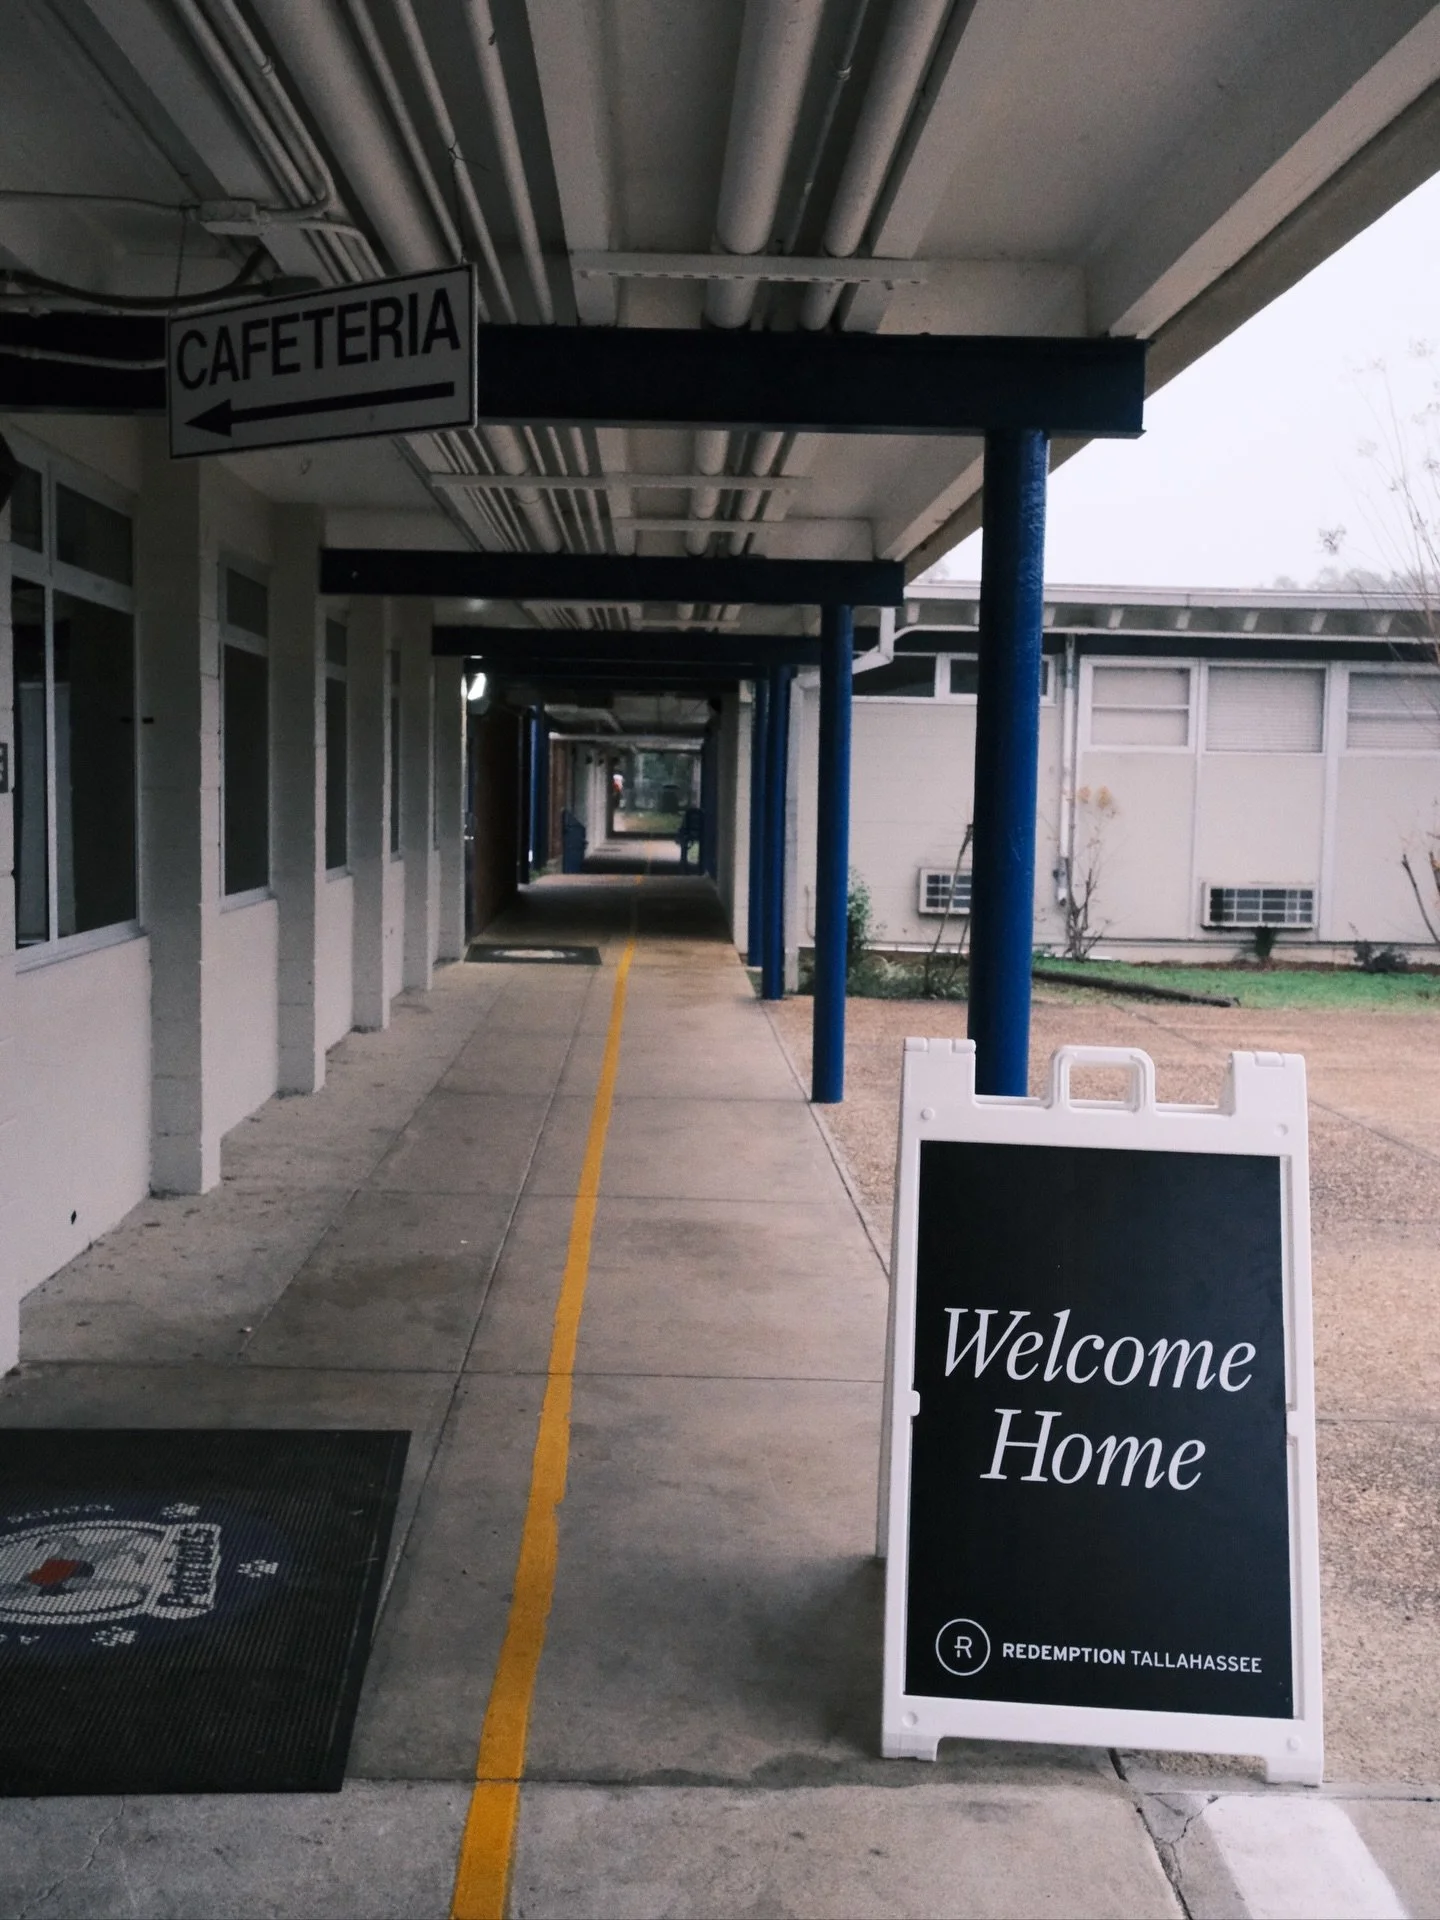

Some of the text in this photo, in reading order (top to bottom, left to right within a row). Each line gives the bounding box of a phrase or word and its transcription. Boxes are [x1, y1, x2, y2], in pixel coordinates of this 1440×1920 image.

[176, 287, 461, 390] CAFETERIA
[943, 1307, 1257, 1392] Welcome
[979, 1408, 1206, 1491] Home
[157, 1527, 215, 1609] Patriots
[1002, 1642, 1263, 1674] REDEMPTION TALLAHASSEE
